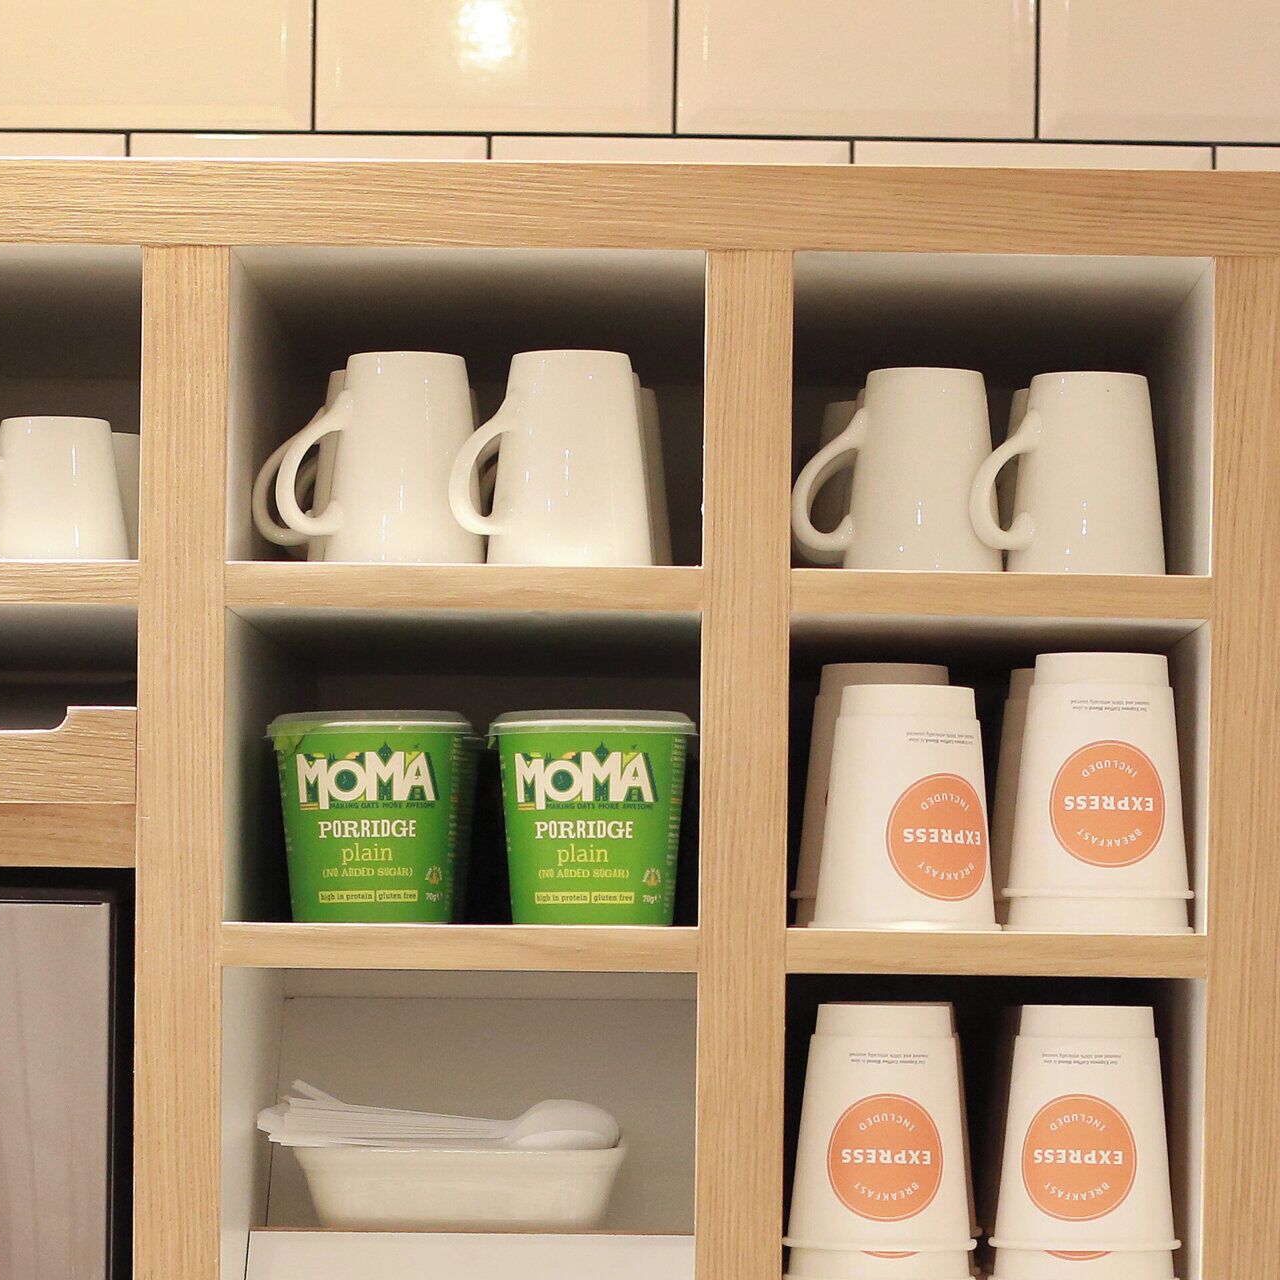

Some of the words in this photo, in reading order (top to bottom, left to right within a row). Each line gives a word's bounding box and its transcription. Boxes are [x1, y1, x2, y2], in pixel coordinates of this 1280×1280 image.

[1081, 759, 1137, 778] INCLUDED
[296, 752, 436, 810] MOMA
[515, 752, 654, 811] MOMA
[577, 802, 595, 810] OATS
[598, 802, 619, 810] MORE
[920, 792, 970, 811] INCLUDED
[1064, 795, 1153, 811] EXPRESS
[318, 820, 417, 839] PORRIDGE
[534, 820, 634, 839] PORRIDGE
[903, 828, 981, 845] EXPRESS
[1076, 828, 1143, 847] BREAKFAST
[341, 843, 393, 866] plain
[557, 844, 609, 866] plain
[341, 867, 375, 878] ADDED
[377, 867, 413, 878] SUGAR)
[556, 868, 590, 878] ADDED
[593, 868, 629, 879] SUGAR)
[918, 861, 975, 880] BREAKFAST
[320, 893, 335, 902] high
[346, 892, 373, 901] protein
[378, 892, 402, 902] gluten
[403, 892, 417, 901] free
[536, 893, 551, 903] high
[561, 893, 588, 903] protein
[593, 893, 617, 903] gluten
[619, 893, 633, 902] free
[859, 1113, 916, 1132] INCLUDED
[1050, 1113, 1106, 1132] INCLUDED
[842, 1148, 931, 1165] EXPRESS
[1034, 1149, 1123, 1165] EXPRESS
[854, 1182, 919, 1200] BREAKFAST
[1044, 1182, 1110, 1200] BREAKFAST
